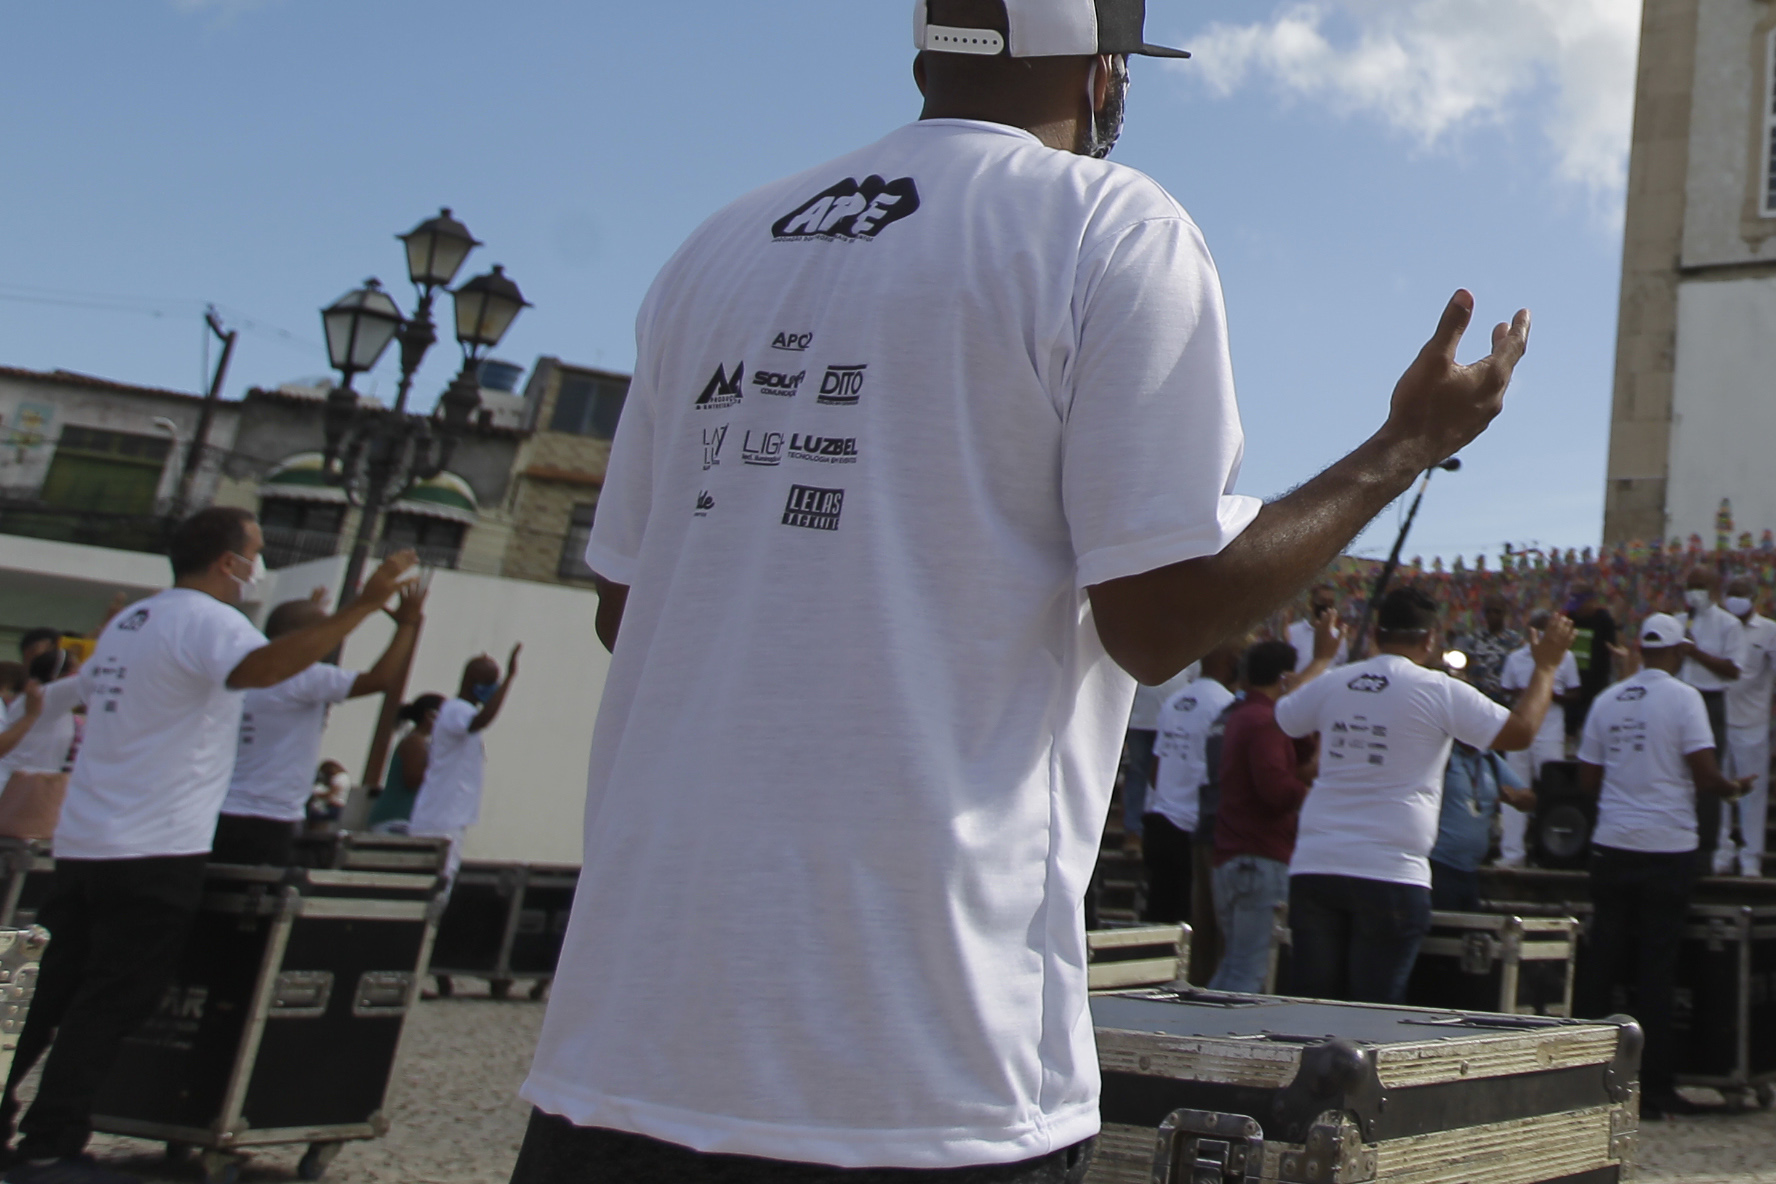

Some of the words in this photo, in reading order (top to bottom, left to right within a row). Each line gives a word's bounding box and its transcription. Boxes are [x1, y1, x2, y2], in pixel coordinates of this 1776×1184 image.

[783, 192, 902, 234] APE
[820, 371, 863, 395] DITO
[789, 433, 858, 455] LUZBEL
[788, 451, 829, 463] TECNOLOGIA
[789, 488, 842, 514] LELAS
